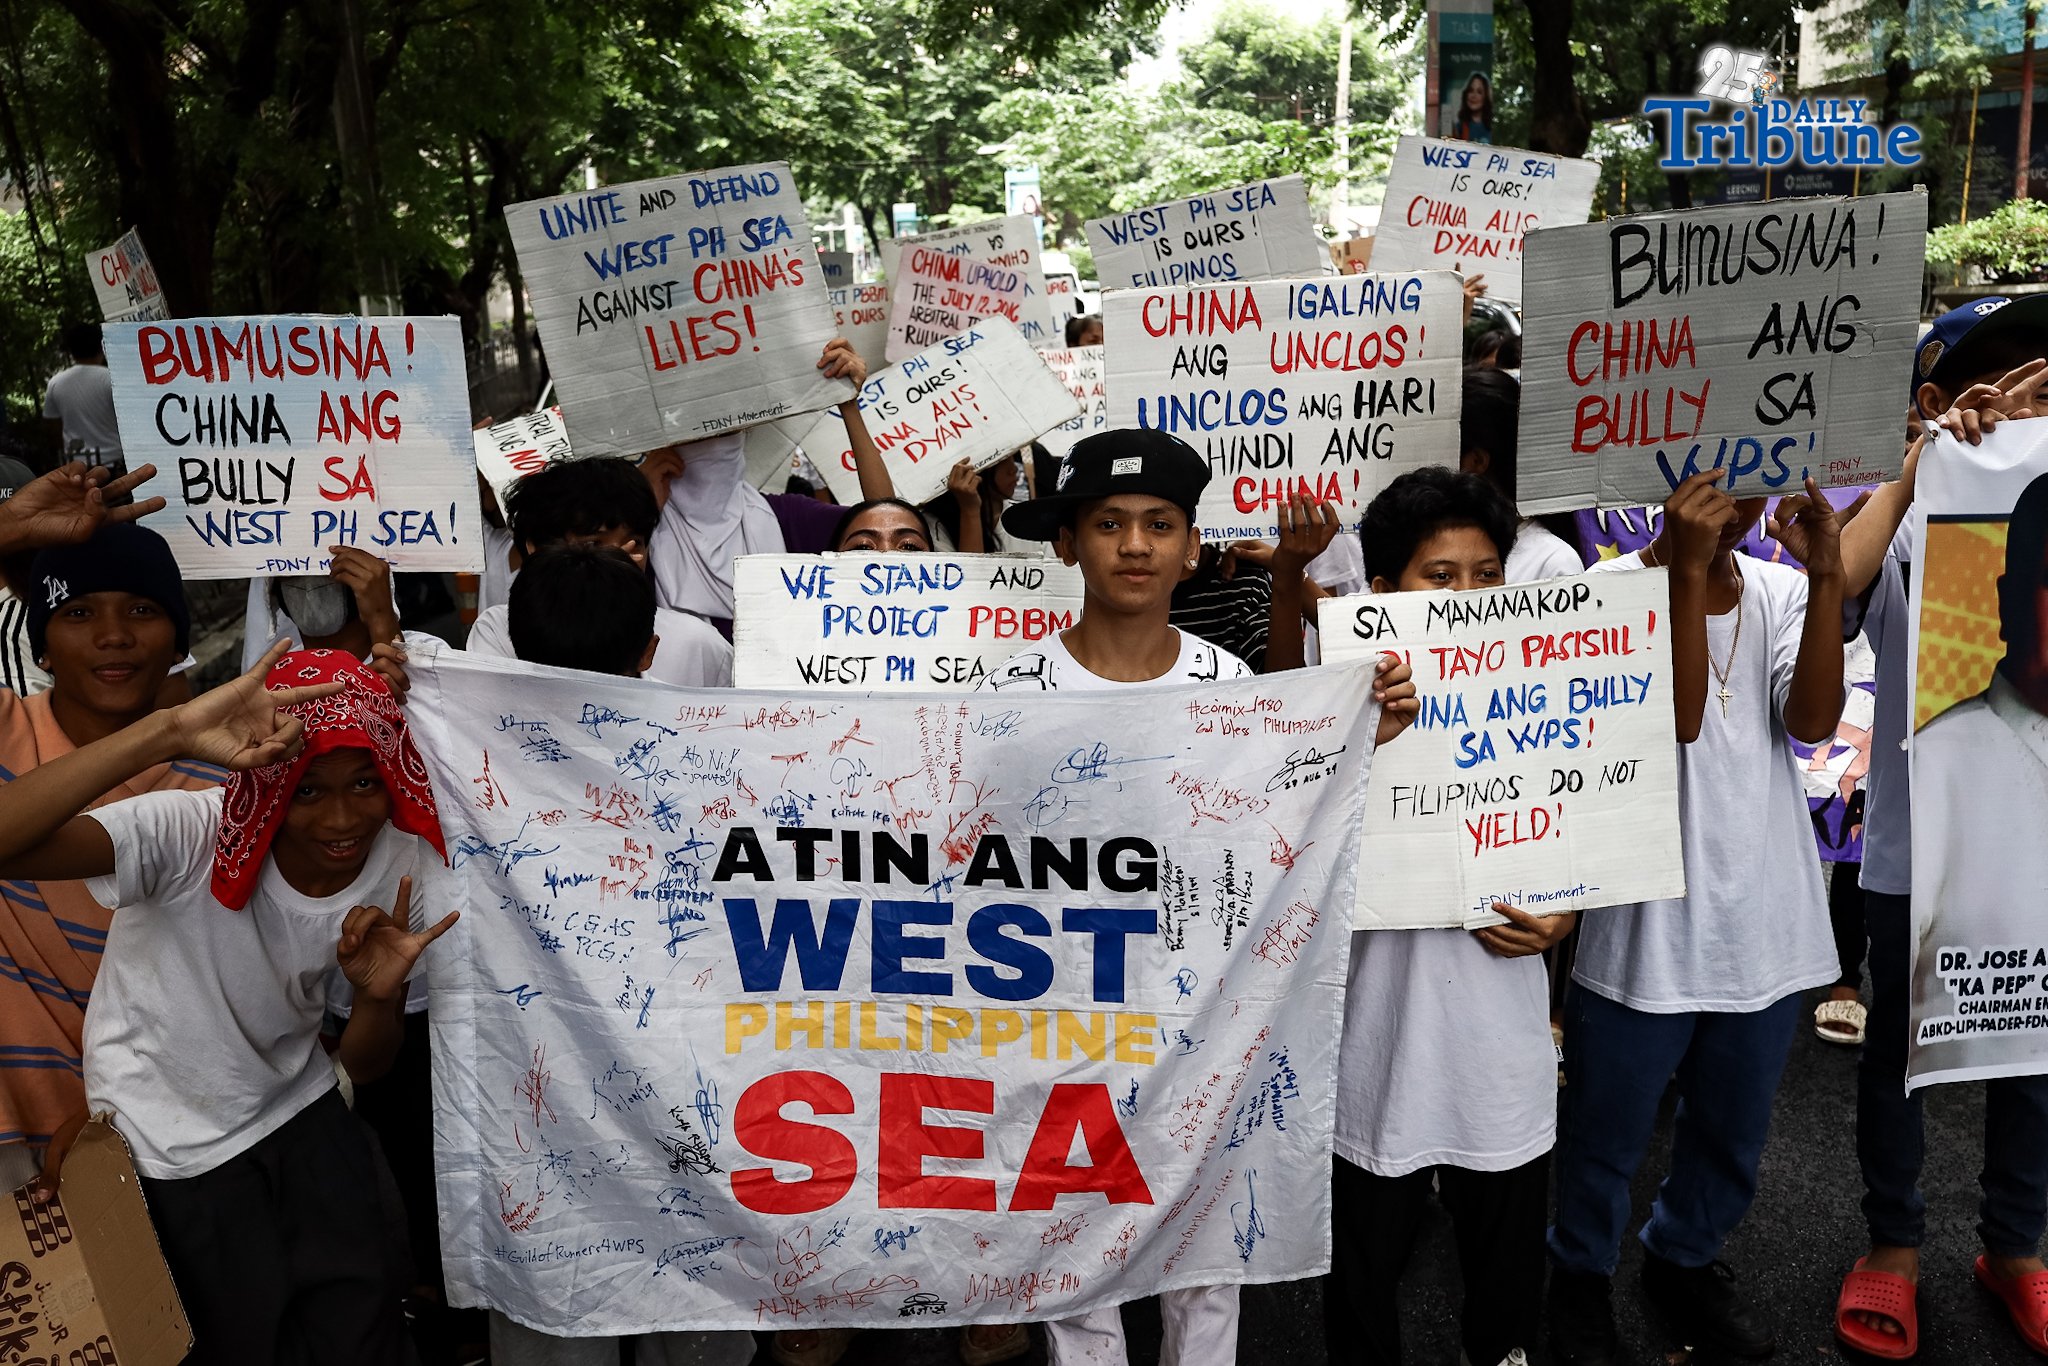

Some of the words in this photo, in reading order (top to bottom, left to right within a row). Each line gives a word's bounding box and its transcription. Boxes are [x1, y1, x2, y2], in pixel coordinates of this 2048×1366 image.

[1423, 146, 1478, 169] WEST
[1486, 154, 1508, 173] PH
[1521, 158, 1557, 180] SEA
[1451, 173, 1471, 193] IS
[1483, 180, 1533, 200] OURS!
[539, 192, 628, 241] UNITE
[639, 189, 677, 217] AND
[688, 171, 782, 209] DEFEND
[1099, 206, 1169, 247] WEST
[1188, 197, 1217, 224] PH
[1226, 183, 1277, 212] SEA
[1407, 195, 1467, 228] CHINA
[1486, 209, 1540, 236] ALIS
[584, 233, 676, 283] WEST
[687, 225, 727, 260] PH
[738, 214, 794, 254] SEA
[1153, 237, 1173, 262] IS
[1183, 214, 1259, 250] OURS!
[966, 265, 1018, 293] UPHOLD
[1131, 252, 1238, 288] FILIPINOS
[576, 280, 680, 337] AGAINST
[851, 306, 886, 326] OURS
[909, 305, 960, 331] ARBITRAL
[913, 283, 936, 305] THE
[941, 287, 974, 313] JULY
[1142, 286, 1262, 338] CHINA
[1288, 277, 1423, 321] IGALANG
[645, 304, 761, 372] LIES!
[902, 355, 929, 380] PH
[943, 330, 984, 357] SEA
[1171, 343, 1229, 381] ANG
[1270, 323, 1426, 375] UNCLOS!
[1567, 315, 1697, 387] CHINA
[1747, 295, 1862, 360] ANG
[875, 401, 899, 420] IS
[906, 359, 968, 404] OURS!
[932, 383, 977, 424] ALIS
[1138, 387, 1288, 433] UNCLOS
[1297, 392, 1343, 421] ANG
[1353, 376, 1436, 419] HARI
[1571, 378, 1711, 454] BULLY
[1755, 371, 1817, 426] SA
[155, 392, 291, 447] CHINA
[317, 389, 401, 445] ANG
[903, 403, 989, 464] DYAN!
[1206, 432, 1294, 477] HINDI
[1321, 422, 1396, 466] ANG
[178, 456, 295, 506] BULLY
[318, 453, 375, 502] SA
[1232, 468, 1361, 515] CHINA!
[186, 508, 291, 547] WEST
[311, 508, 358, 548] PH
[371, 501, 458, 545] SEA!
[780, 564, 836, 600] WE
[860, 562, 965, 596] STAND
[989, 566, 1044, 591] AND
[823, 604, 949, 639] PROTECT
[968, 606, 1073, 641] PBBM
[1353, 605, 1398, 641] SA
[796, 654, 877, 686] WEST
[885, 655, 915, 682] PH
[929, 655, 985, 685] SEA
[1429, 640, 1506, 682] TAYO
[674, 704, 727, 721] SHARK
[1486, 684, 1547, 720] ANG
[1568, 672, 1653, 715] BULLY
[1221, 716, 1251, 738] bless
[1455, 730, 1497, 770] SA
[1507, 717, 1595, 756] WPS!
[1390, 774, 1522, 821] FILIPINOS
[1548, 768, 1584, 797] DO
[1599, 758, 1644, 794] NOT
[1465, 802, 1563, 859] YIELD!
[712, 826, 930, 886] ATIN
[962, 834, 1158, 893] ANG
[723, 898, 1158, 1005] WEST
[1940, 951, 1972, 972] DR.
[1978, 948, 2028, 970] JOSE
[1949, 976, 1985, 997] "KA
[1992, 974, 2036, 995] PEP"
[1958, 997, 2032, 1015] CHAIRMAN
[724, 1002, 1158, 1065] PHILIPPINE
[729, 1069, 1156, 1215] SEA
